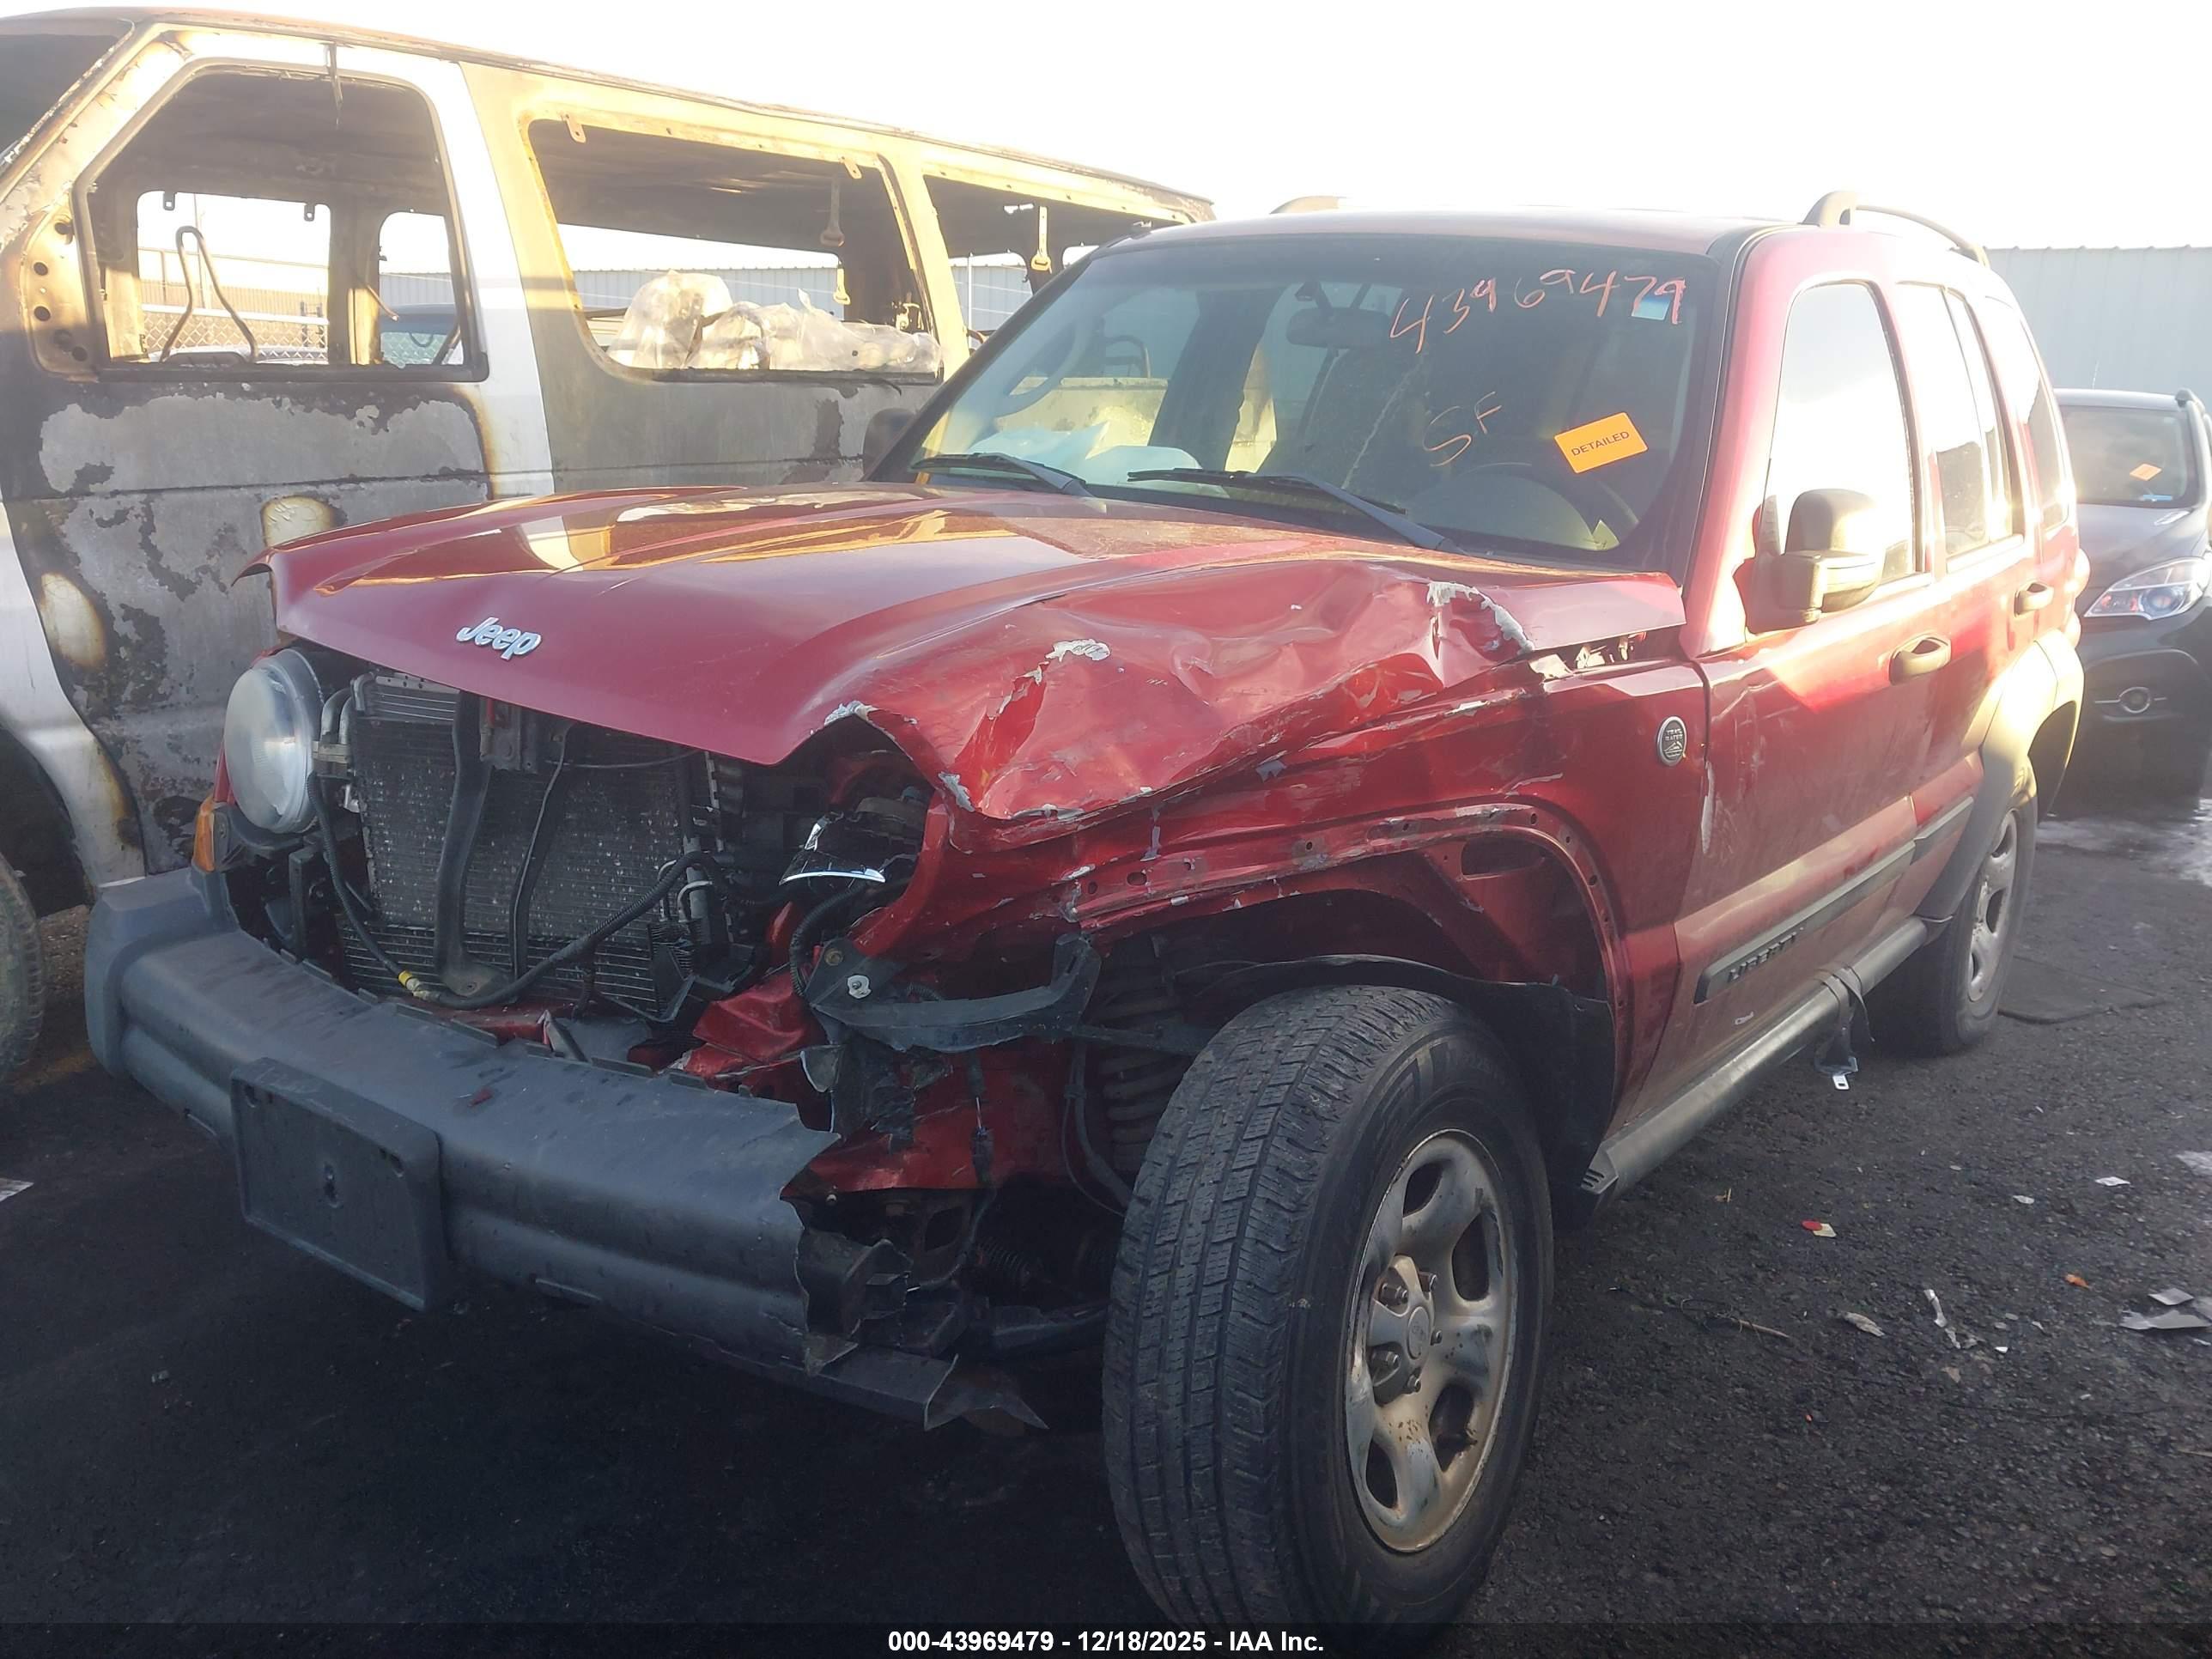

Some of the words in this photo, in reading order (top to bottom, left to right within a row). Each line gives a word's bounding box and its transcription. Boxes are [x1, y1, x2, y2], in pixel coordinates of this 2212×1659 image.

[1389, 269, 1686, 354] 43969479
[1422, 391, 1503, 467] SF
[1571, 431, 1630, 456] DETAILED
[455, 617, 542, 660] Jeep
